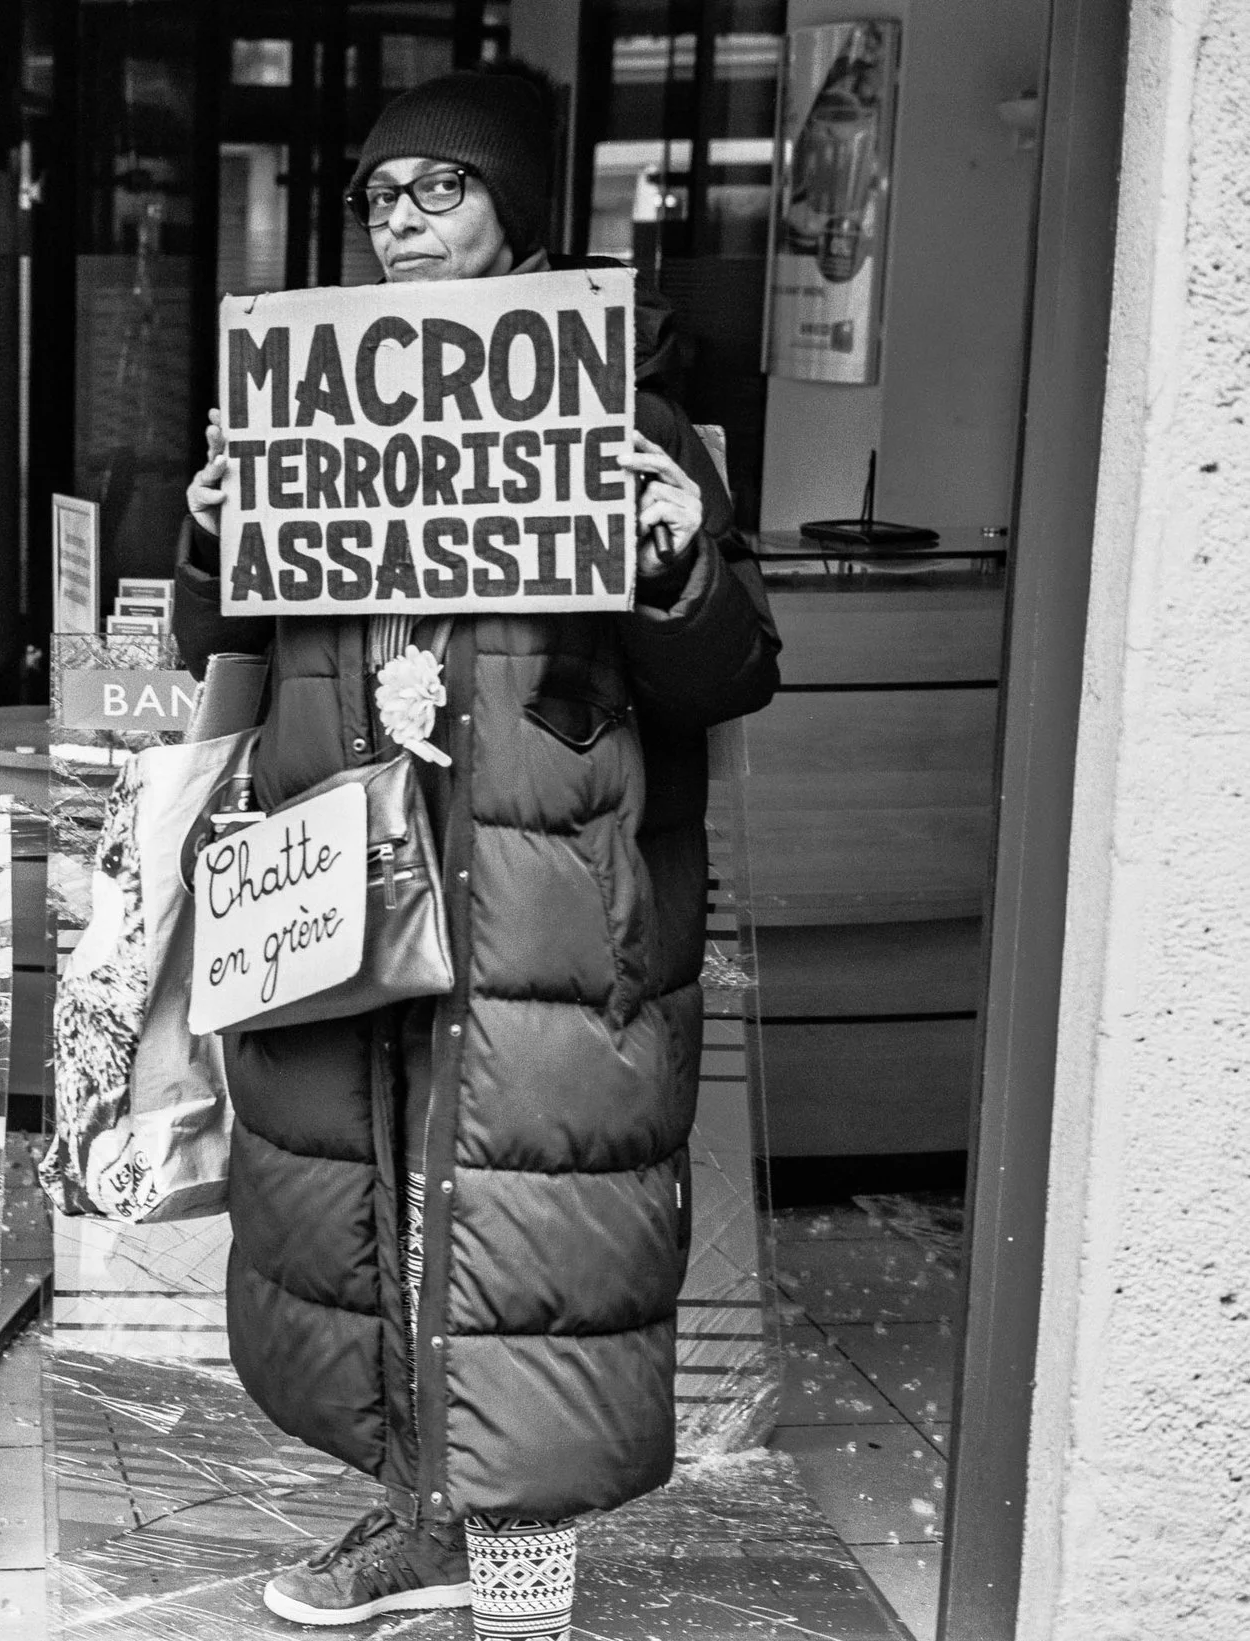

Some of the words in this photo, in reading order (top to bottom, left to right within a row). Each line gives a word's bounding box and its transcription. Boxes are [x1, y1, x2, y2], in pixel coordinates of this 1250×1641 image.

[228, 306, 626, 430] MACRON
[228, 426, 626, 511] TERRORISTE
[230, 513, 626, 602] ASSASSIN
[206, 819, 343, 919] Chatte
[209, 947, 251, 986] en
[260, 905, 344, 1004] grève
